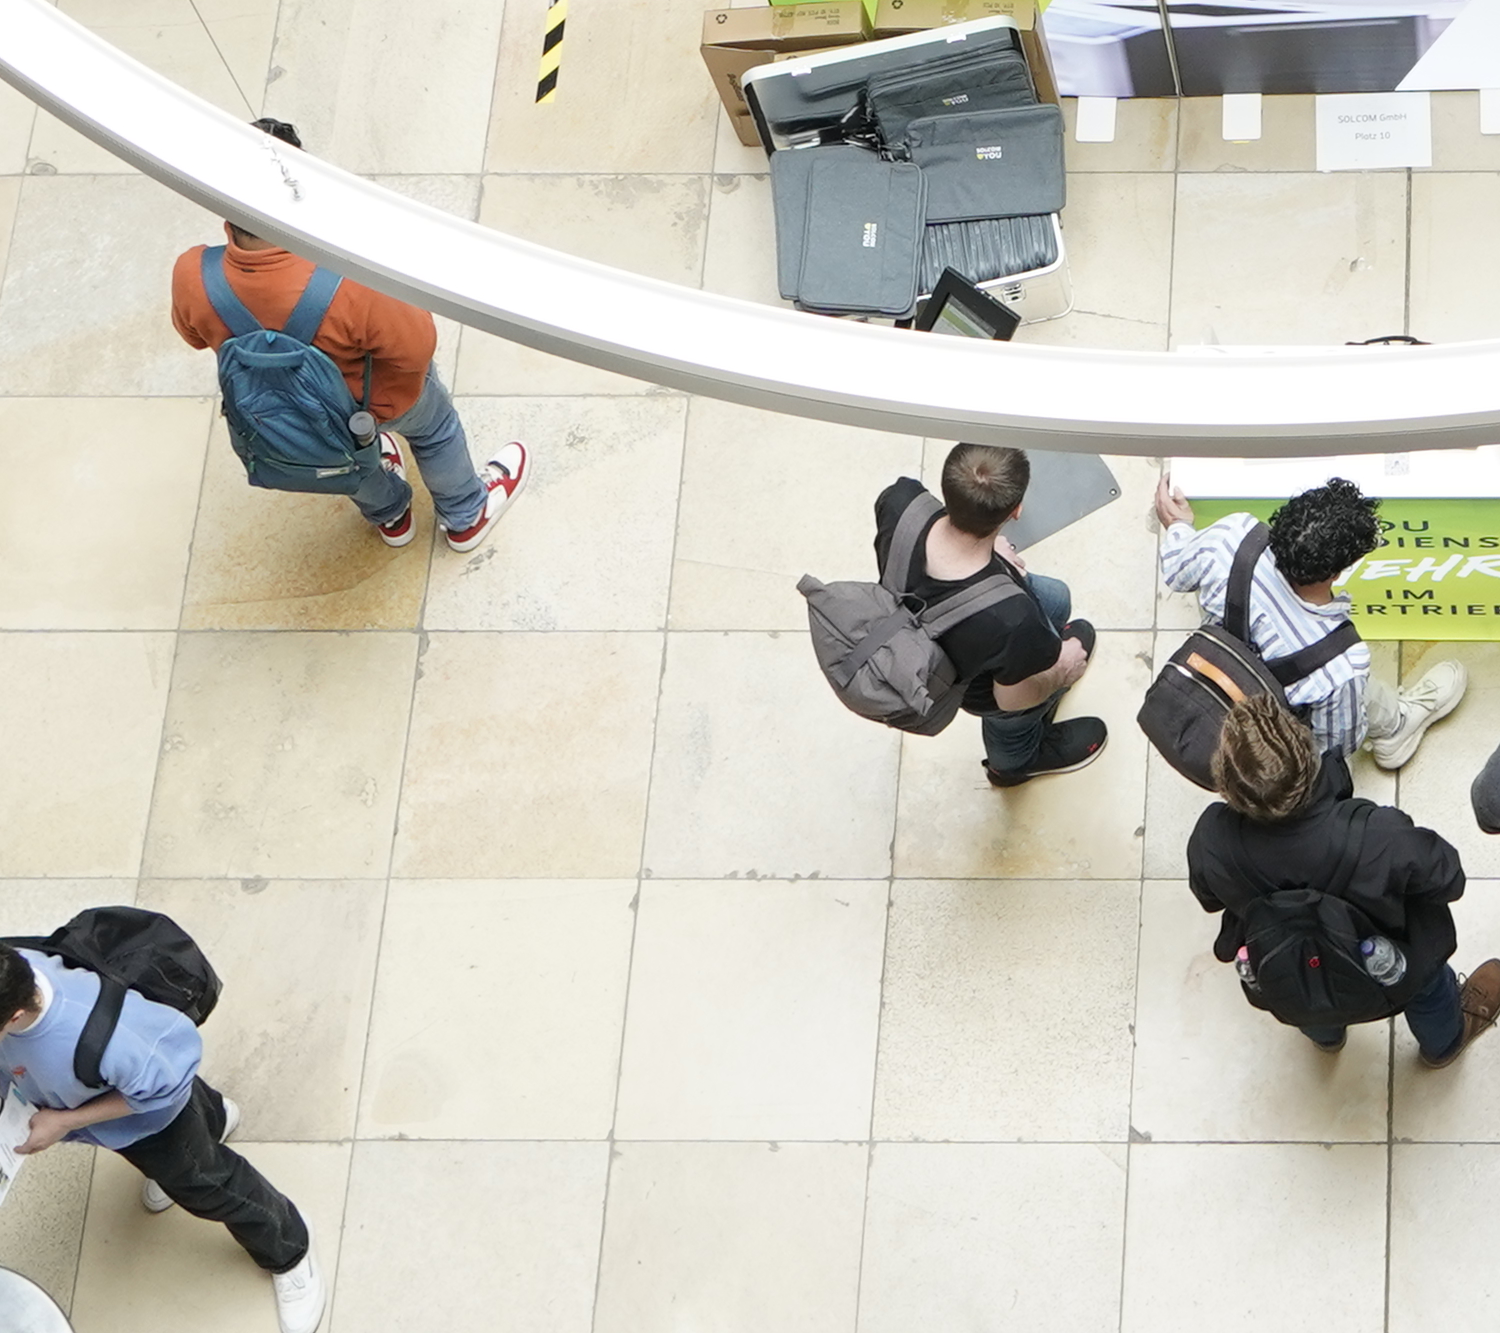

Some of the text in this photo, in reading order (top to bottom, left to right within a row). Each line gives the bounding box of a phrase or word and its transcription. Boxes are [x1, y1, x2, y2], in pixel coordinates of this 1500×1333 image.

[1337, 113, 1407, 124] SOLCOM GmbH
[1355, 131, 1391, 141] Platz 10
[1385, 589, 1435, 600] IM
